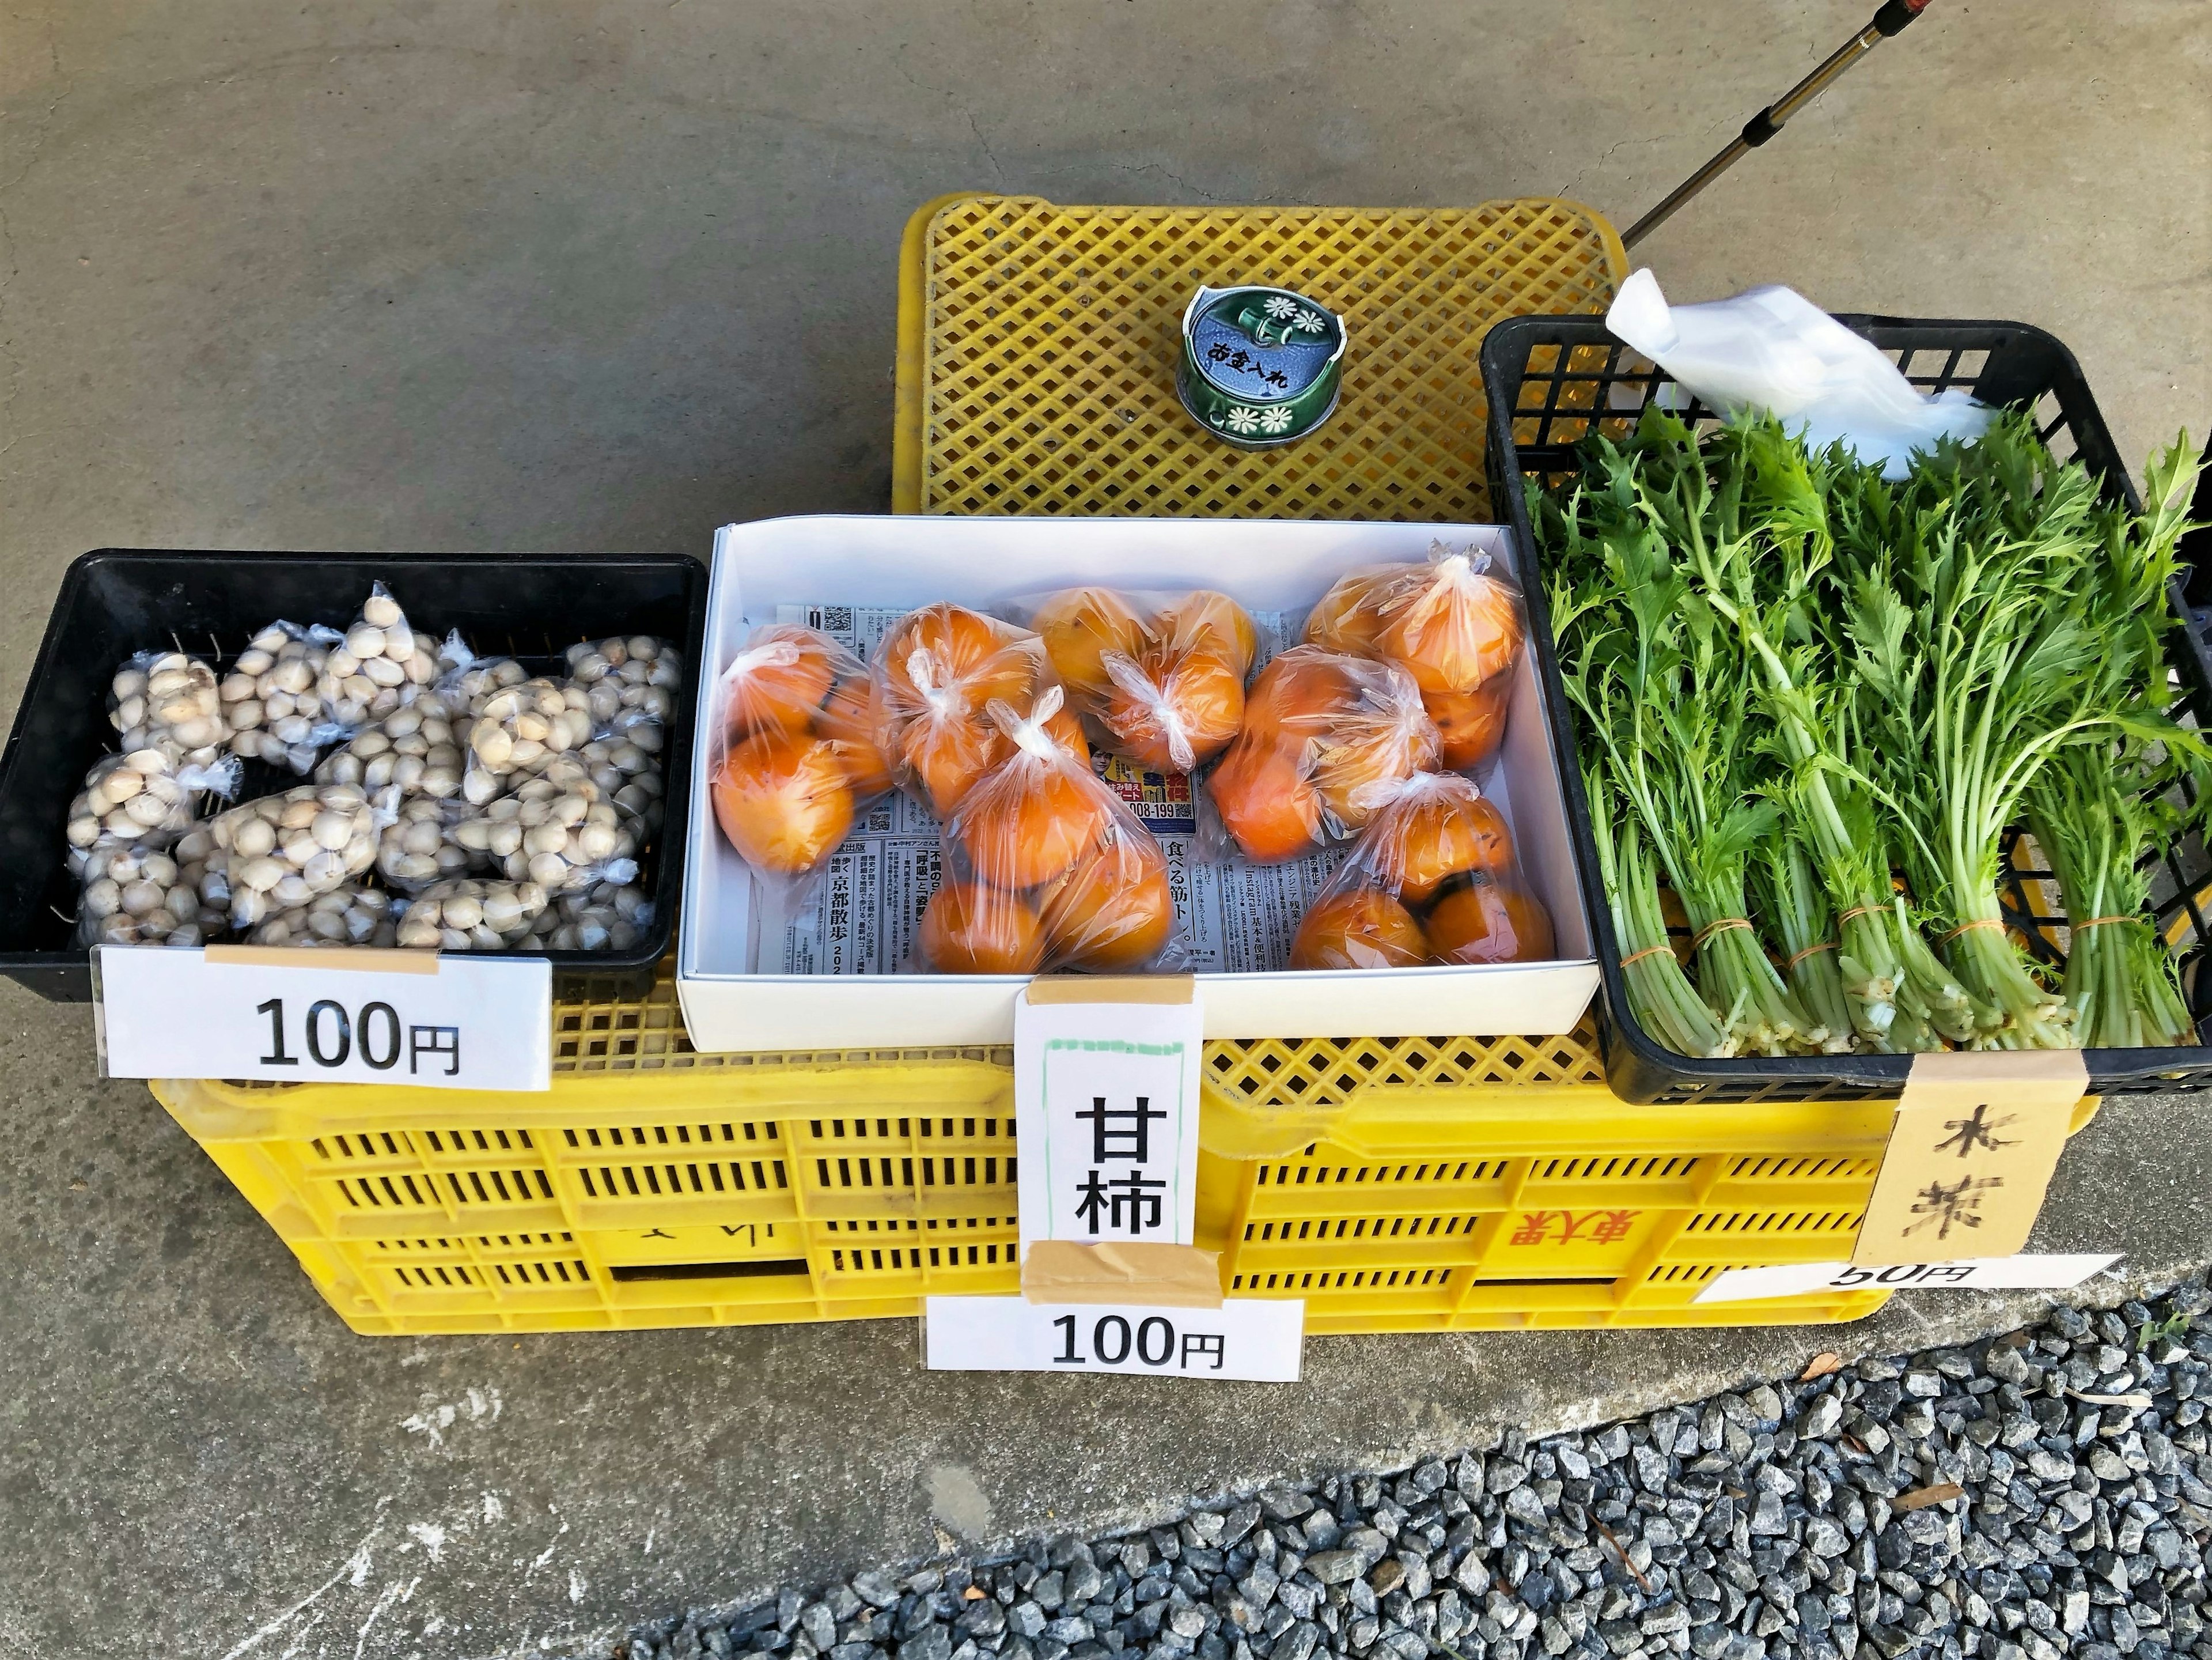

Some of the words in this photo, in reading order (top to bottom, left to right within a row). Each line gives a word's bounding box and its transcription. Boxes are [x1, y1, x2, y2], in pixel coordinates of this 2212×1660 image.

[1207, 342, 1288, 389] お金入れ
[256, 998, 460, 1076] 100円
[1074, 1096, 1167, 1235] 甘柿
[1901, 1104, 2024, 1241] 水菜
[1509, 1211, 1643, 1246] 東大果
[1828, 1263, 1976, 1287] 50円
[1052, 1314, 1225, 1370] 100円
